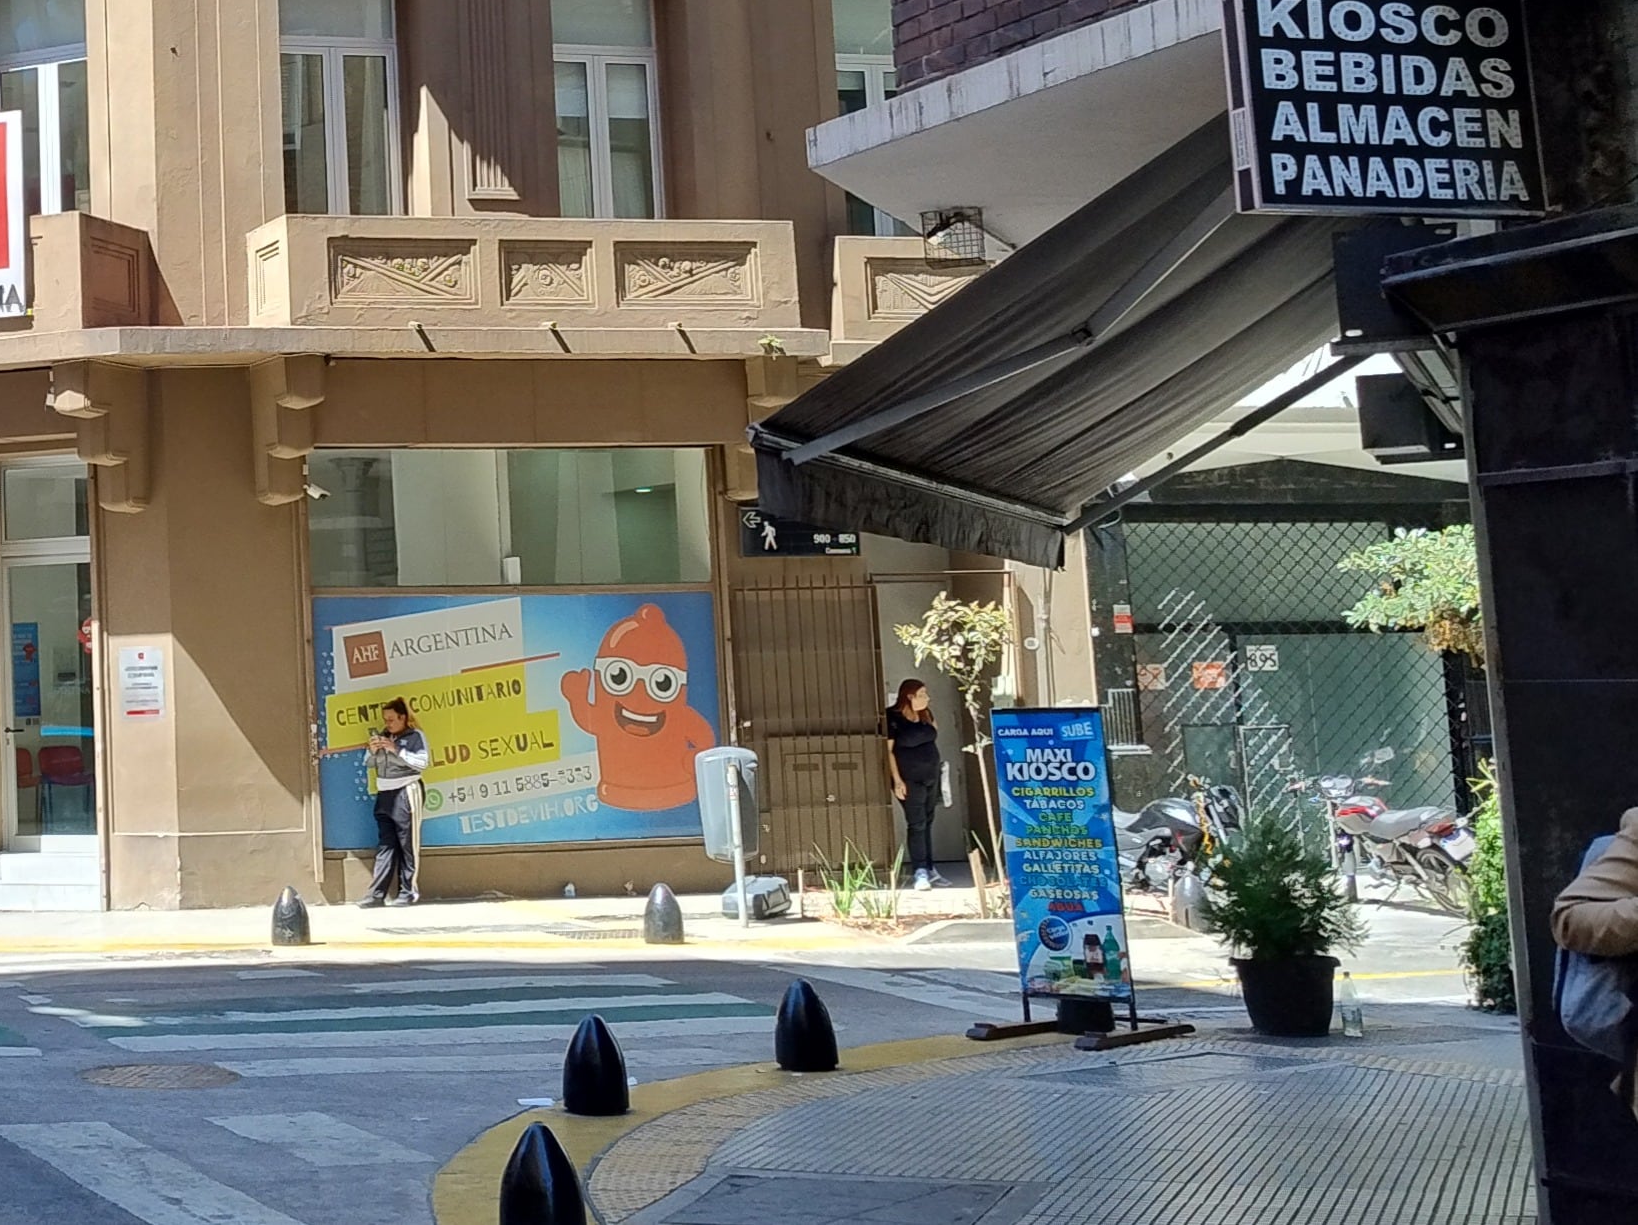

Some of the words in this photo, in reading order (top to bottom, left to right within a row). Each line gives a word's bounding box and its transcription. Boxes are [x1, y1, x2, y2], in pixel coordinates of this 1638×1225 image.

[1261, 48, 1515, 98] BEBIDAS
[1271, 101, 1523, 149] ALMACEN
[1270, 153, 1530, 201] PANADERIA
[813, 534, 831, 544] 900
[352, 643, 380, 664] AHF
[389, 623, 513, 659] ARGENTINA
[1247, 652, 1277, 669] 895
[336, 701, 387, 726] CENT
[408, 678, 522, 713] COMUNITARIO
[997, 728, 1029, 737] CARGA
[1030, 728, 1054, 737] AQUI
[1061, 722, 1094, 738] SUBE
[477, 730, 555, 760] SEXUAL
[1026, 748, 1073, 763] MAXI
[1005, 762, 1096, 781] KIOSCO
[478, 783, 489, 798] 9
[493, 780, 511, 795] 11
[1012, 786, 1095, 797] CIGARRILLOS
[1023, 799, 1085, 810] TABACOS
[458, 794, 599, 834] TESTDEVIH.ORG
[1038, 812, 1073, 823] CAFE
[1025, 824, 1088, 835] PANCHOS
[1015, 837, 1102, 848] SANDWICHES
[1023, 850, 1098, 861] ALFAJORES
[1022, 863, 1100, 874] GALLETITAS
[1028, 888, 1099, 901] GASEOSAS
